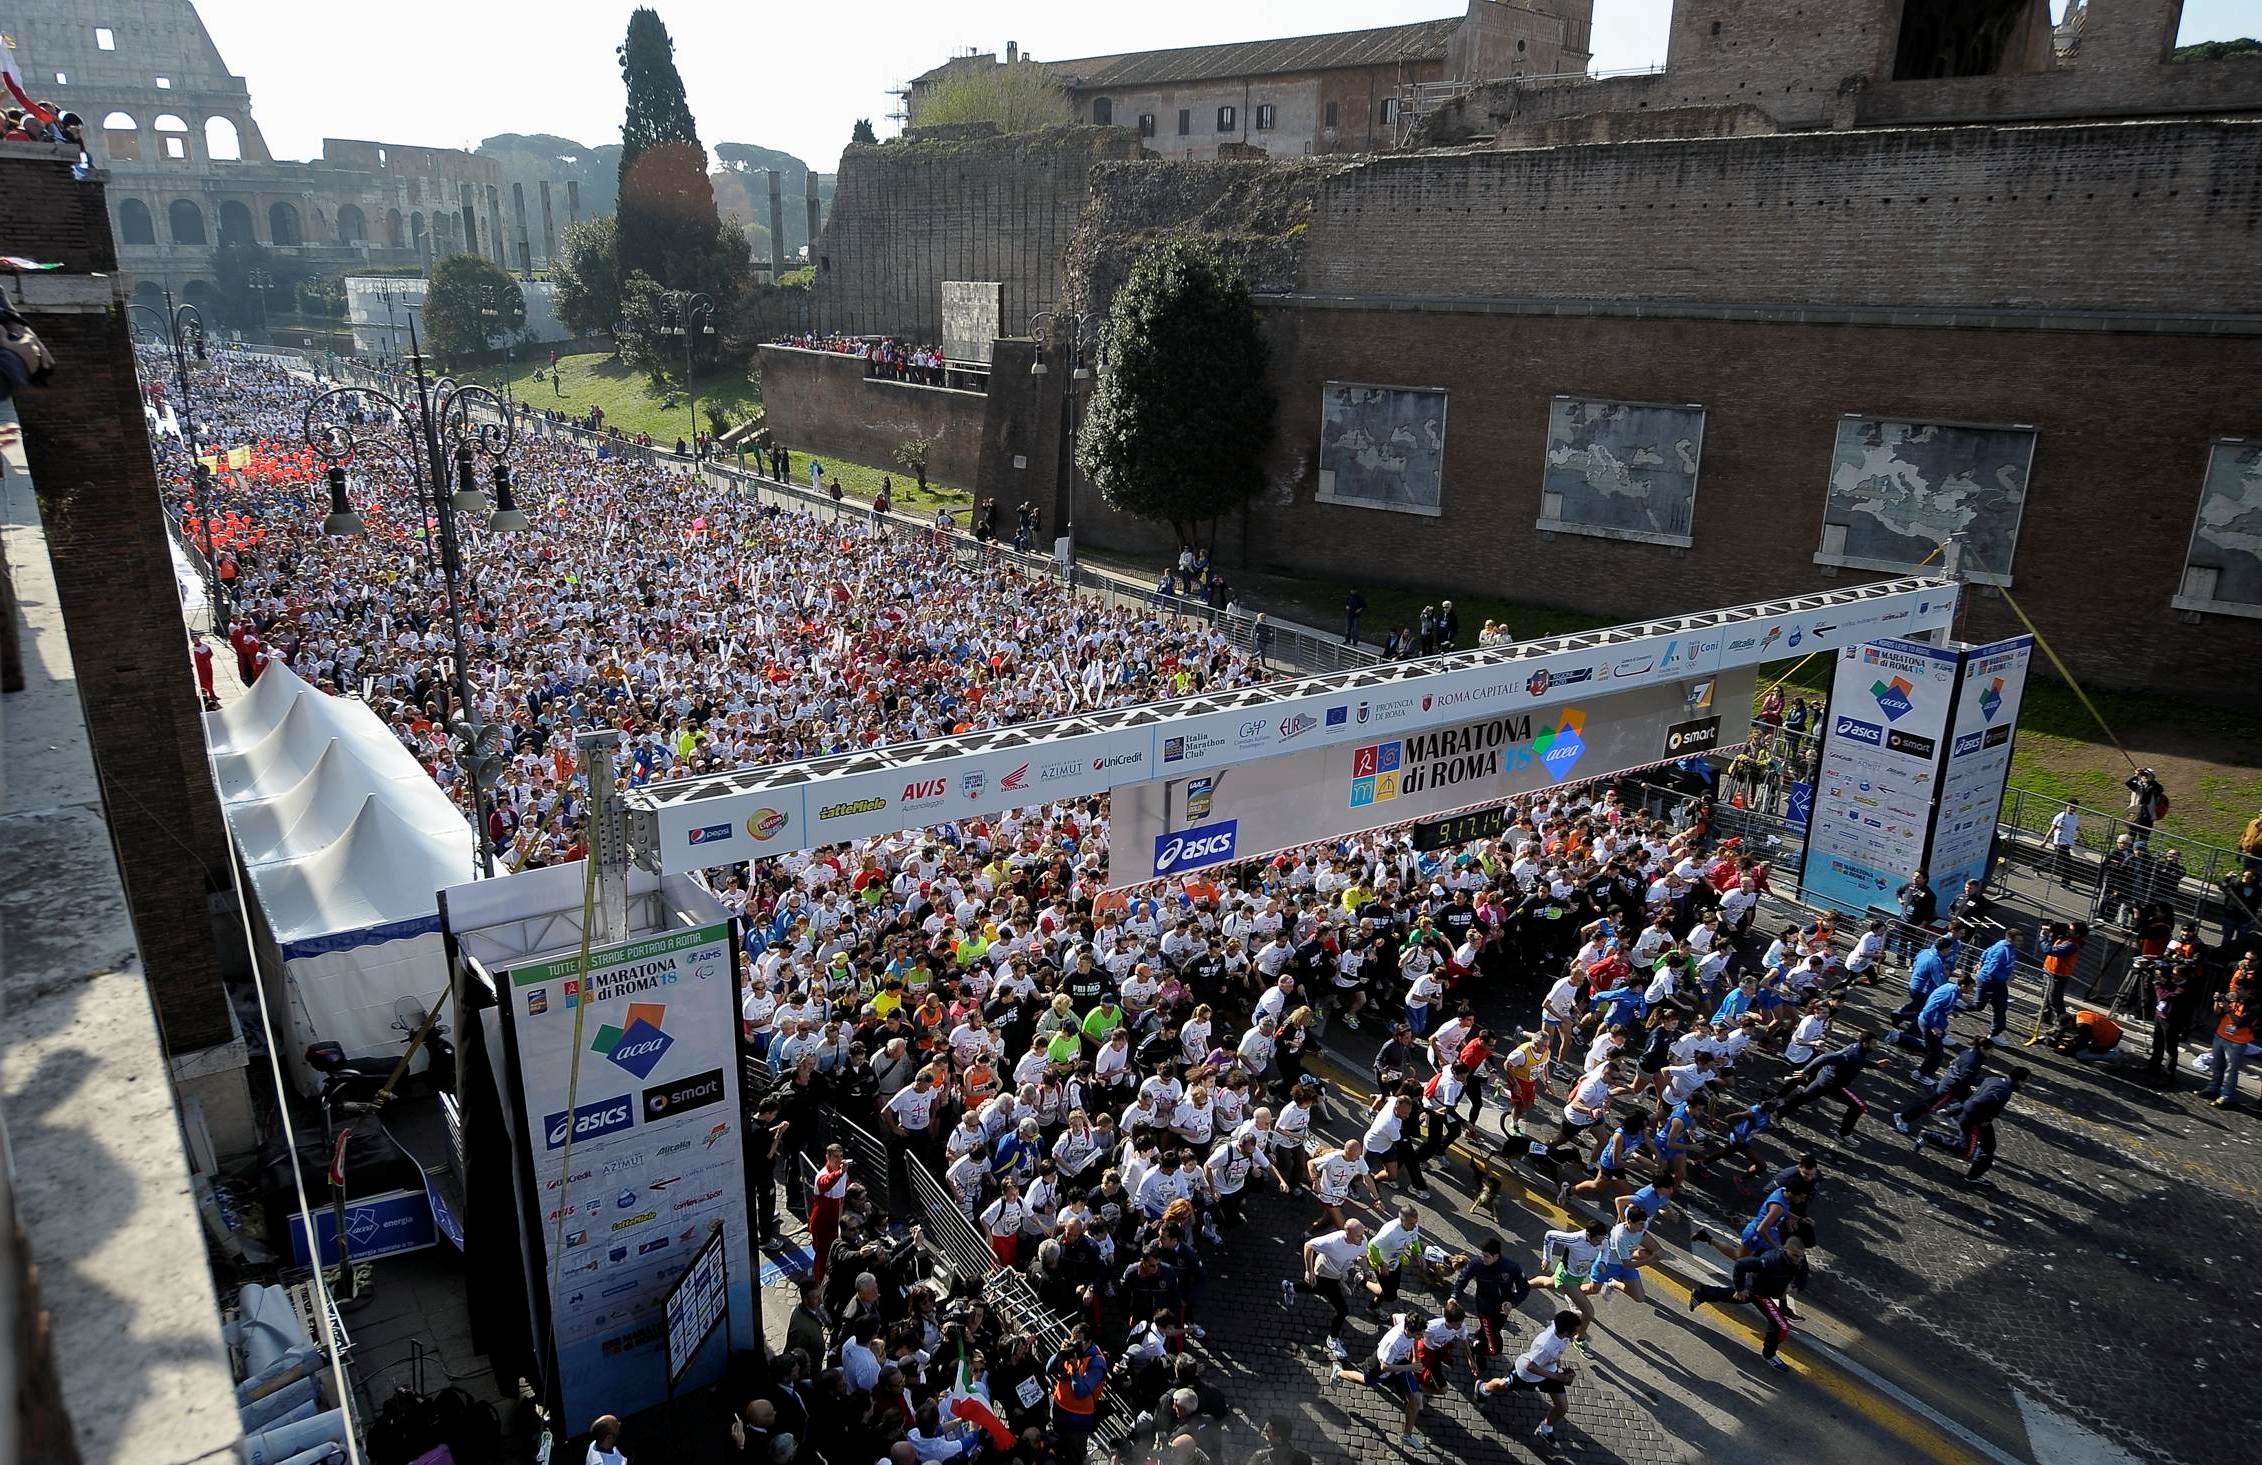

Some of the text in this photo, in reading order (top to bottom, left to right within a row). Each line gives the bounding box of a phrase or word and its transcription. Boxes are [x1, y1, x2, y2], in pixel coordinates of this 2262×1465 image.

[1879, 659, 1889, 668] di
[1881, 651, 1926, 668] MARATONA
[1437, 682, 1520, 708] ROMA CAPITALE
[1375, 699, 1414, 713] PROVINCIA
[1880, 697, 1909, 710] acea
[1383, 708, 1406, 720] ROMA
[1280, 717, 1300, 737] EUR
[1682, 726, 1716, 744] smart
[1851, 725, 1880, 740] asics
[1185, 732, 1208, 743] Italia
[1185, 737, 1225, 752] Marathon
[1405, 715, 1532, 766] MARATONA
[1185, 749, 1205, 759] Club
[1546, 743, 1579, 762] acea
[1902, 740, 1931, 753] smart
[1104, 752, 1143, 768] UniCredit
[1041, 763, 1083, 779] AZIMUT
[1402, 765, 1424, 795] di
[1430, 751, 1498, 789] ROMA
[901, 778, 946, 802] AVIS
[1001, 783, 1030, 793] HONDA
[819, 797, 887, 821] LatteMiele
[758, 814, 783, 830] Lipton
[706, 826, 730, 839] pepsi
[1181, 832, 1232, 860] asics
[548, 962, 576, 977] TUTTE
[591, 951, 626, 968] STRADE
[627, 941, 666, 960] PORTANO
[667, 939, 675, 949] A
[698, 950, 722, 963] AIMS
[596, 958, 677, 988] MARATONA
[598, 986, 612, 1001] di
[616, 1036, 664, 1061] acea
[671, 1080, 718, 1104] smart
[575, 1105, 628, 1132] asics
[656, 1140, 691, 1157] Alitalia
[602, 1155, 644, 1176] AZIMUT
[383, 1216, 414, 1229] energia
